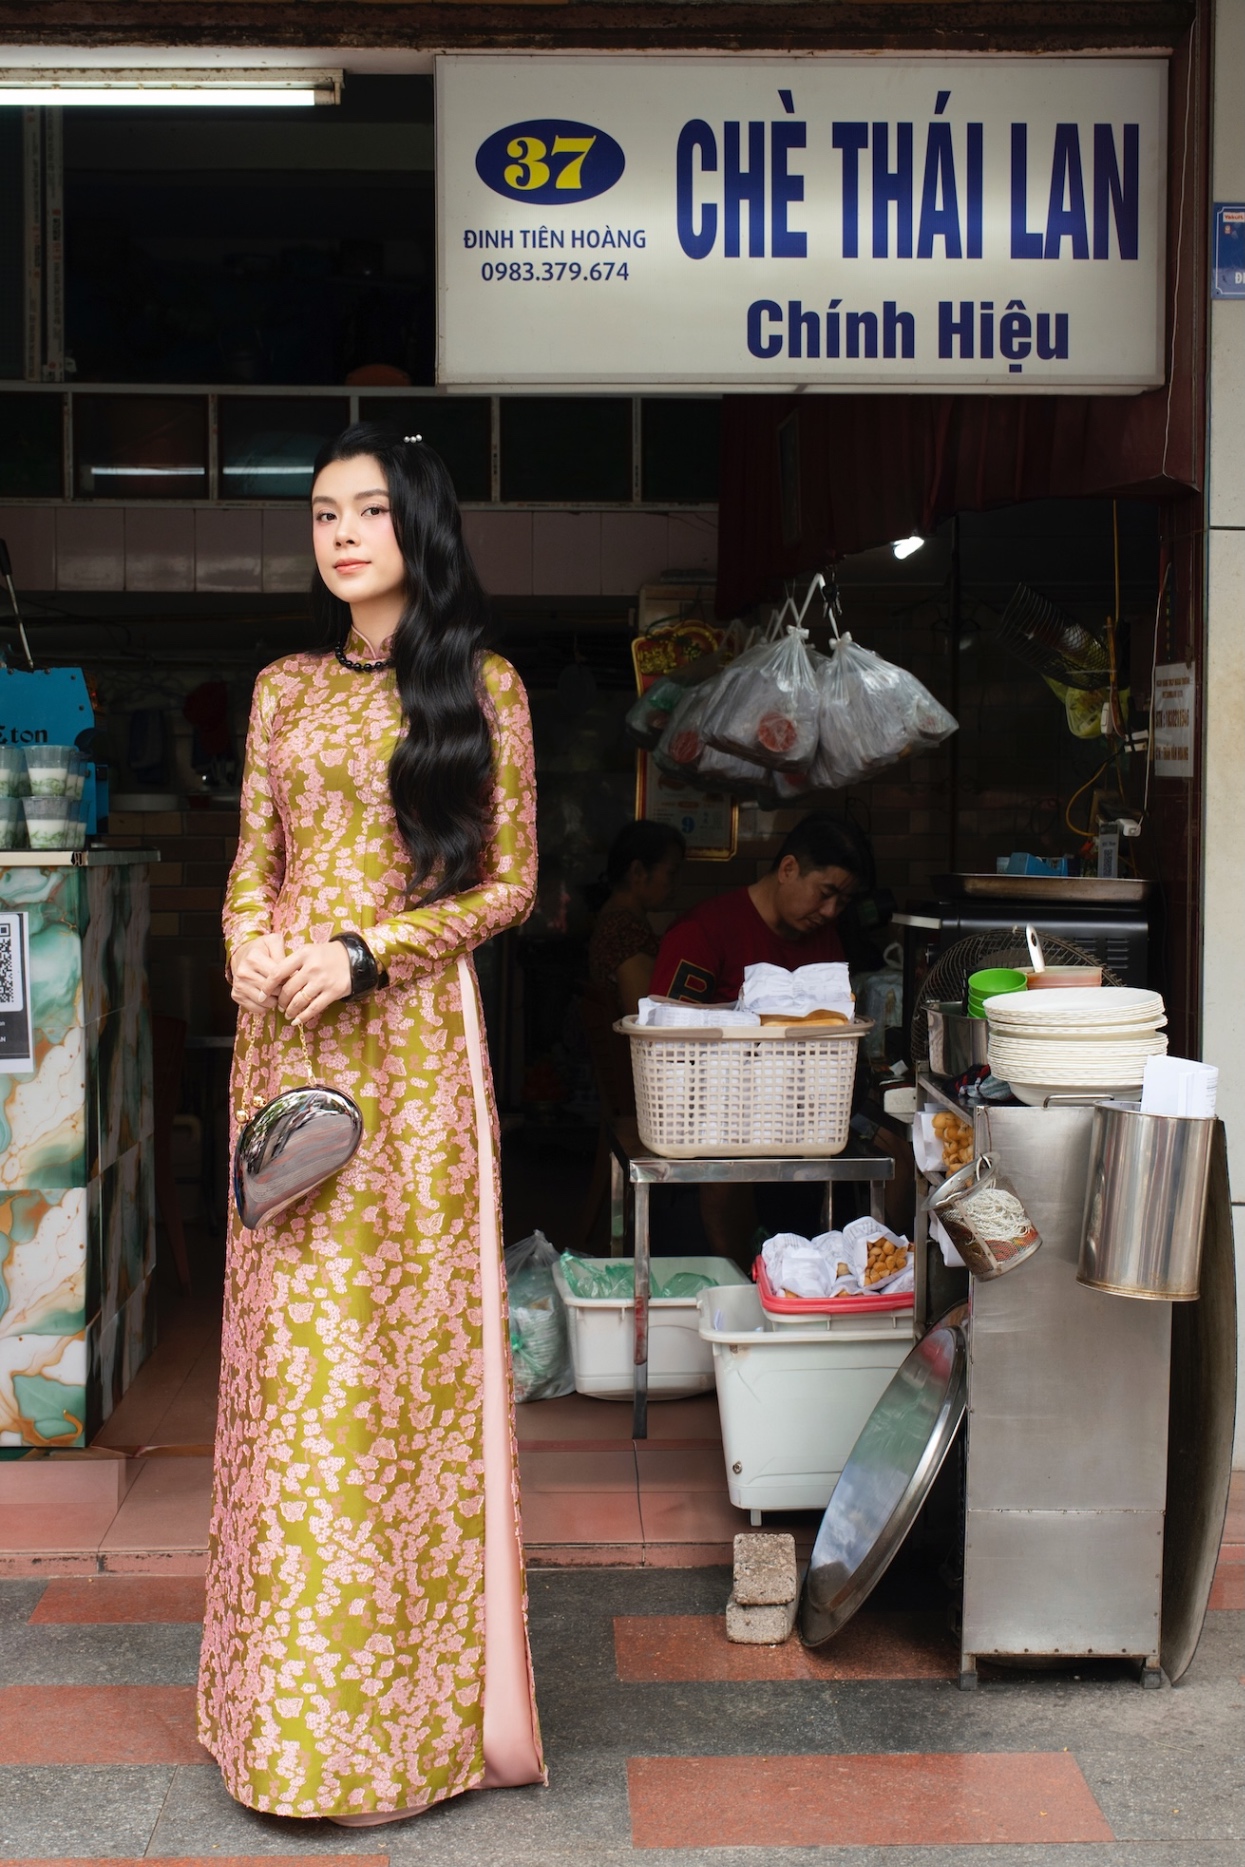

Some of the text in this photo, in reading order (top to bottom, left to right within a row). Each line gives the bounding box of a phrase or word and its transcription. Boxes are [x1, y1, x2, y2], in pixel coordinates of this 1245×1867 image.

[503, 135, 597, 191] 37
[676, 89, 1141, 261] CHÈ THÁI LAN
[463, 225, 646, 249] ĐINH TIÊN HOÀNG
[481, 262, 629, 282] 0983.379.674
[746, 299, 1069, 373] Chính Hiệu
